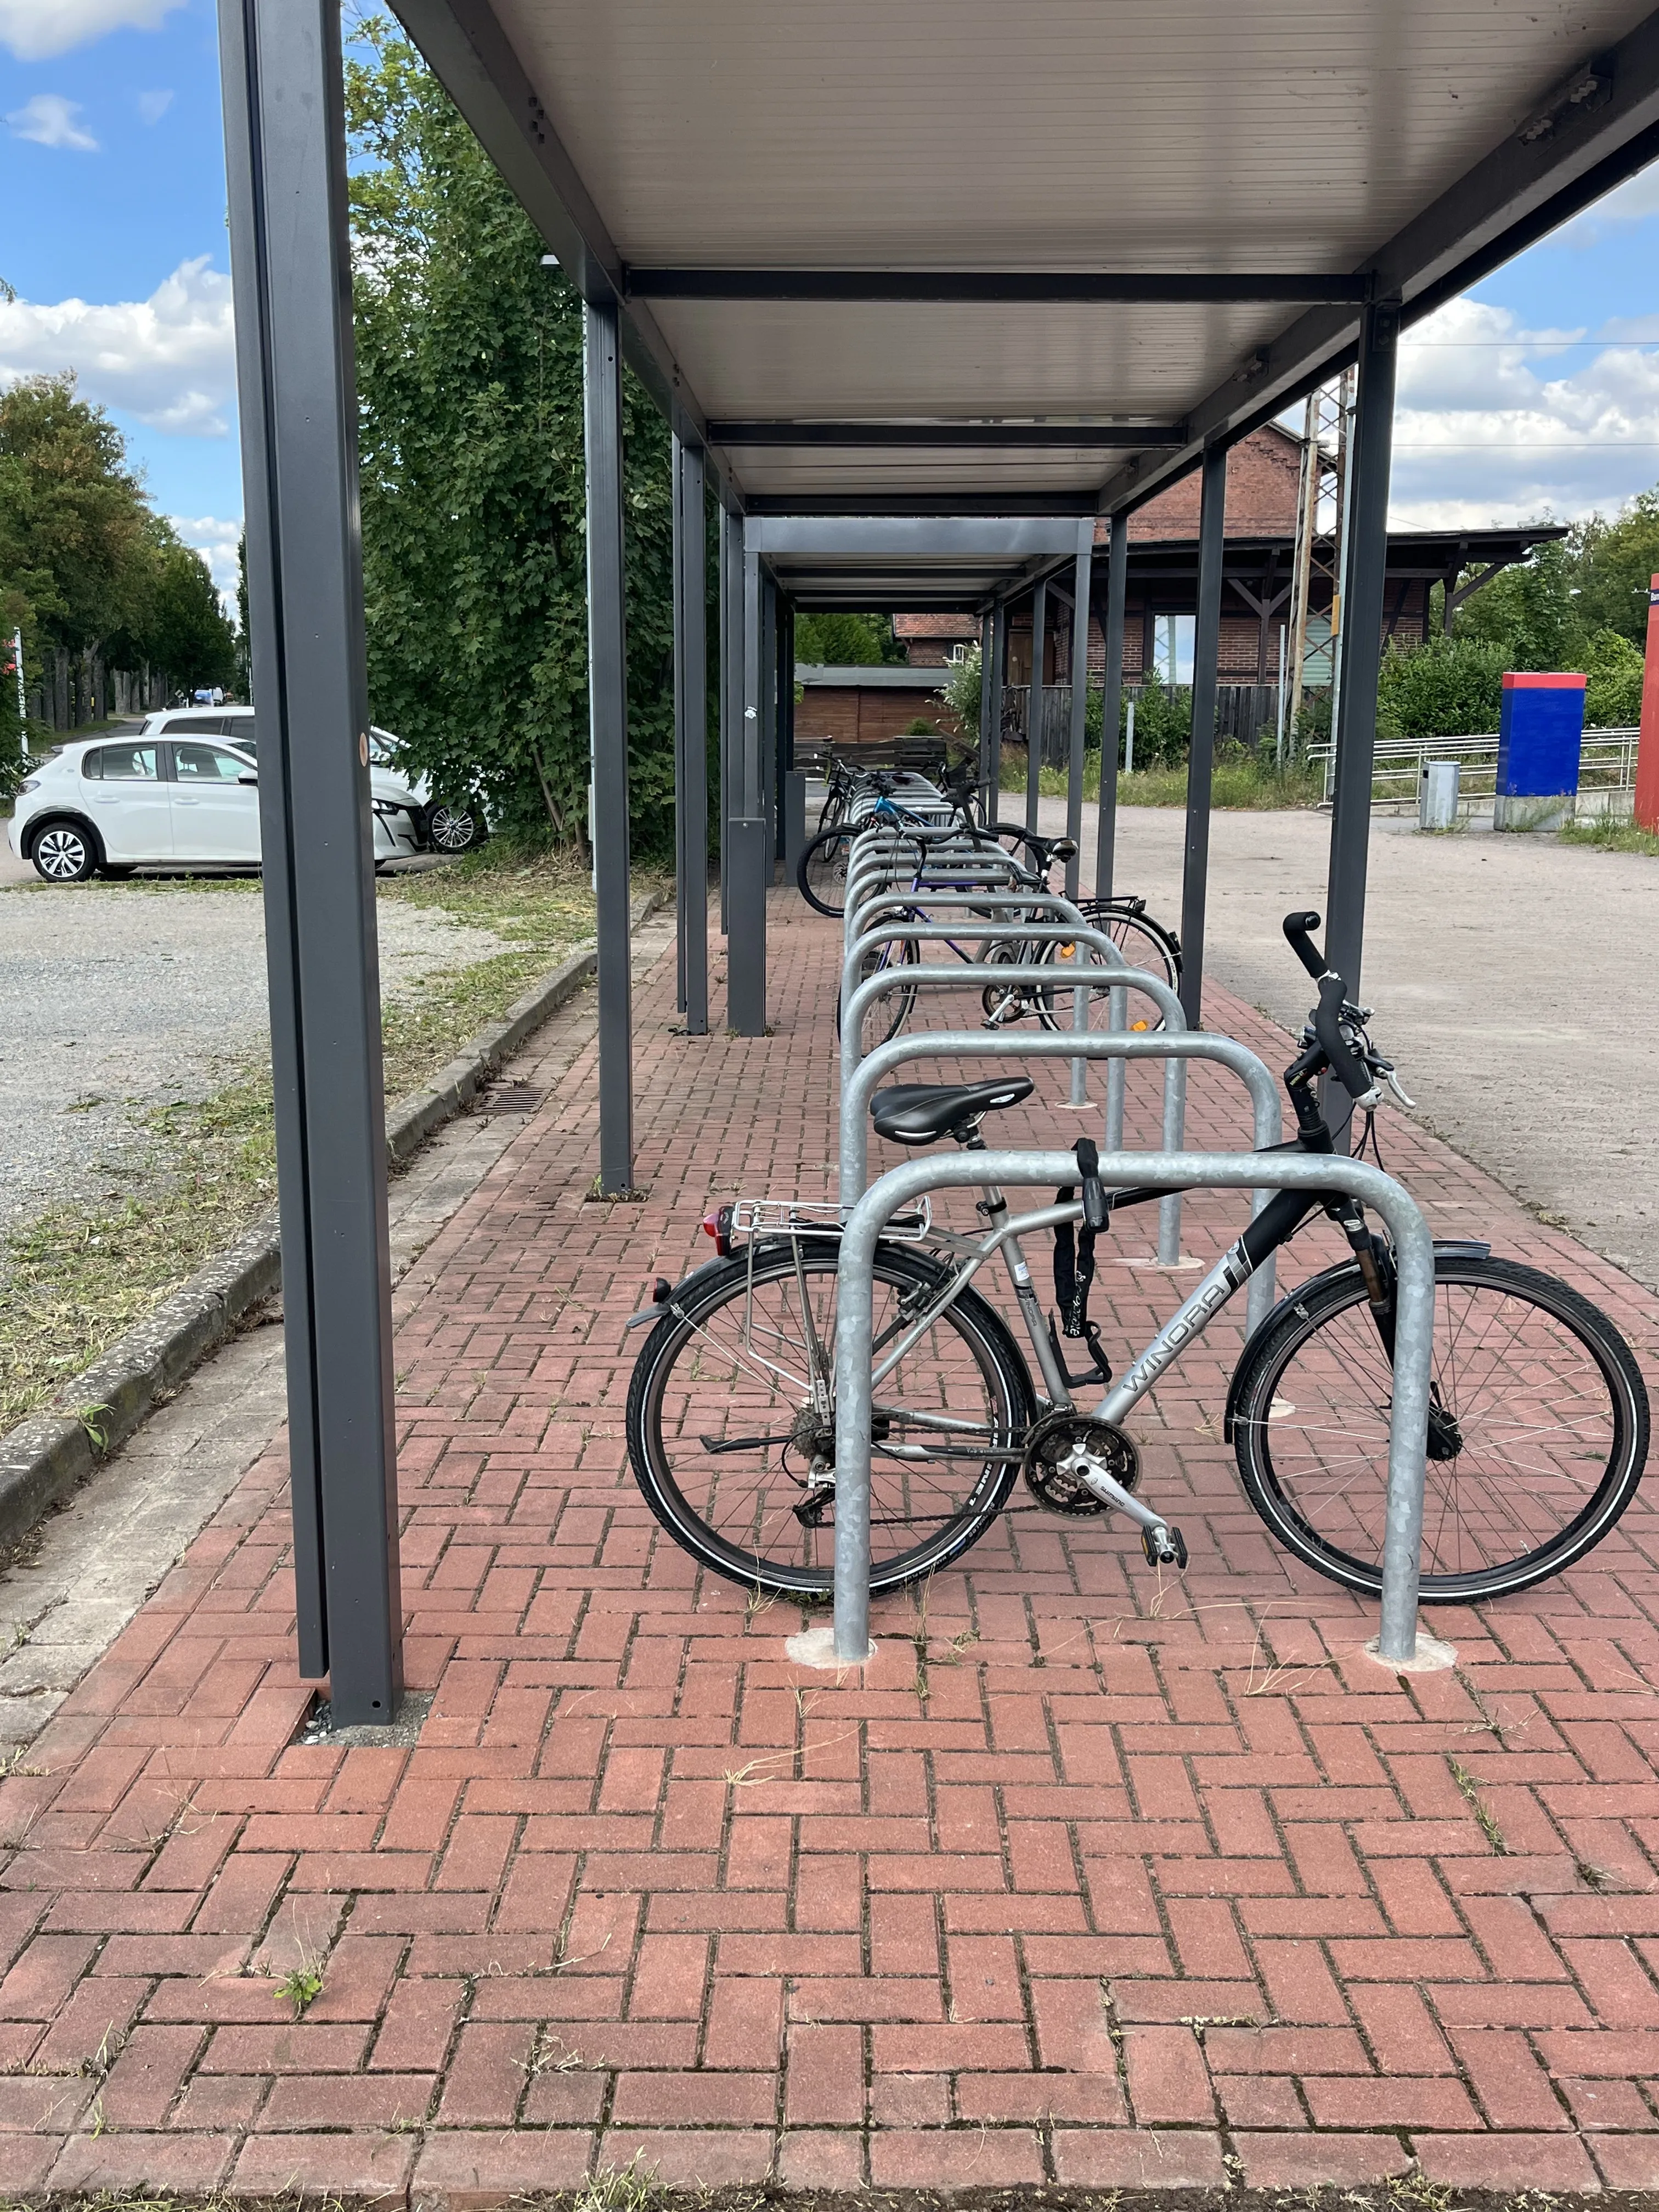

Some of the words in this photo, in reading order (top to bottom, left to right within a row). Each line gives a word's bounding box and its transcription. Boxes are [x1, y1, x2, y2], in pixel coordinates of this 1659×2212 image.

[1122, 1284, 1224, 1391] WINORA
[1100, 1486, 1125, 1507] SHIMANO
[968, 1502, 995, 1537] SCWALBE
[919, 1555, 947, 1575] MARHON
